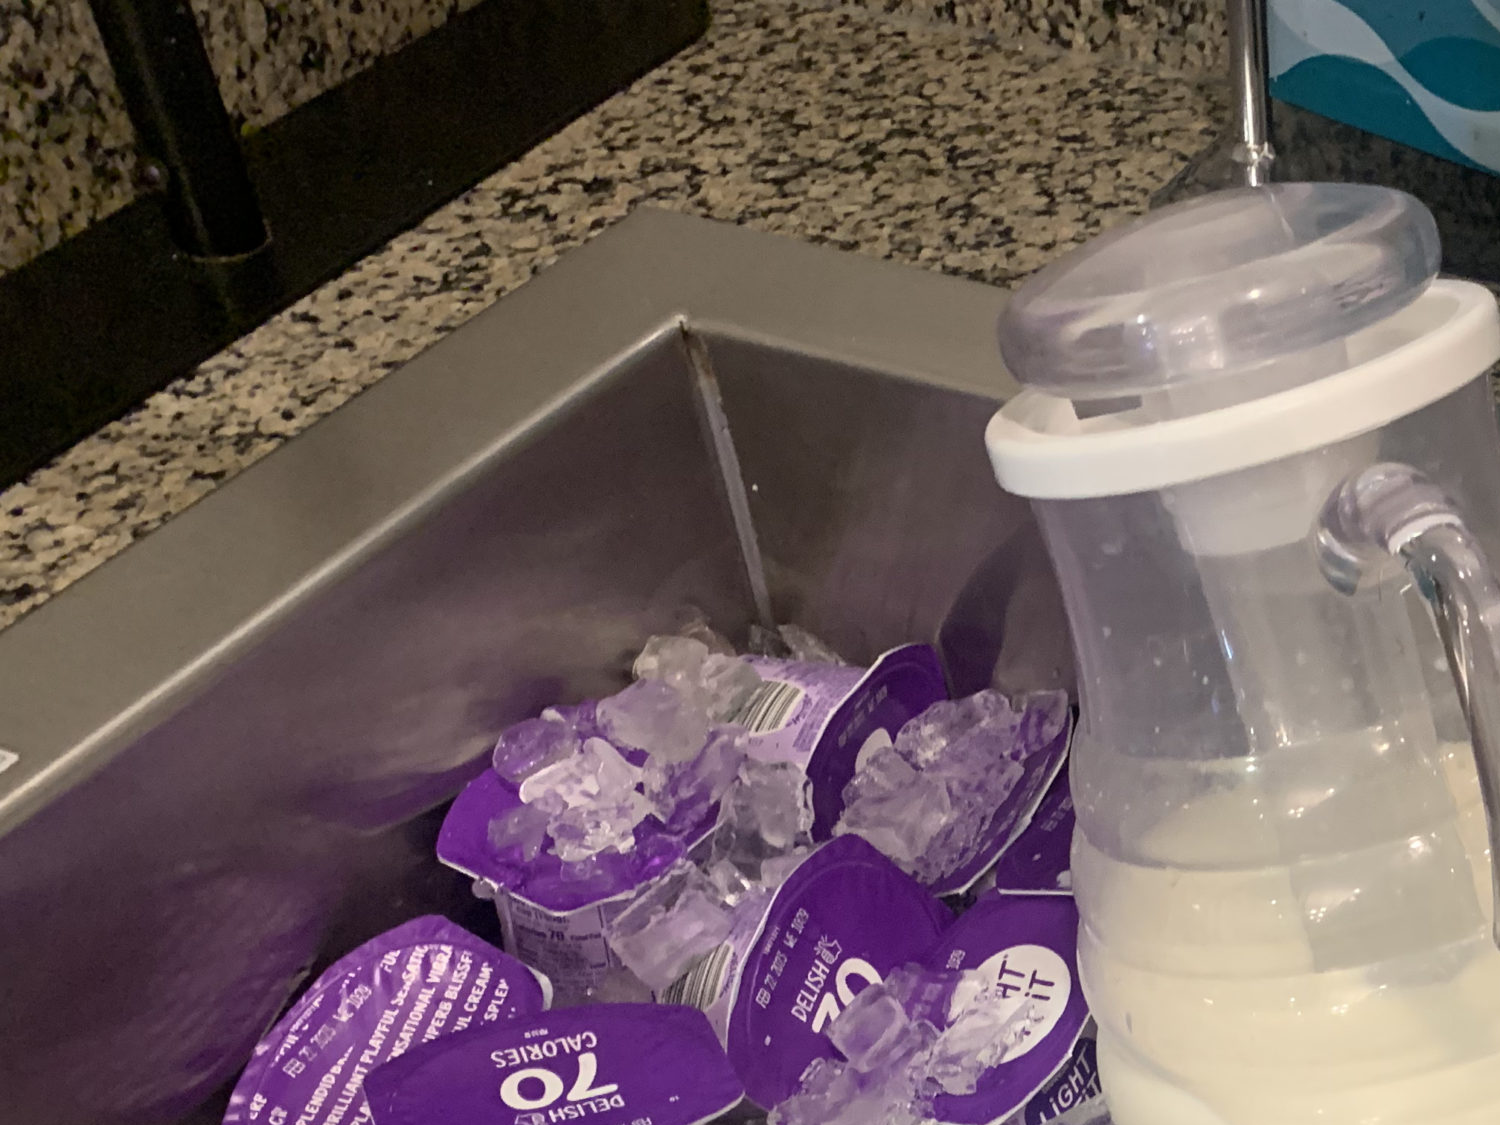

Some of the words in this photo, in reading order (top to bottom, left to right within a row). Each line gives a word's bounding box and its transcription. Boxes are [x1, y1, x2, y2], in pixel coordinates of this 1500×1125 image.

[790, 959, 830, 1022] DELISH
[811, 959, 882, 1031] 70
[359, 1007, 399, 1064] PLAYFUL
[490, 1031, 597, 1068] CALORIES
[500, 1053, 618, 1109] 70
[548, 1094, 624, 1122] DELISH
